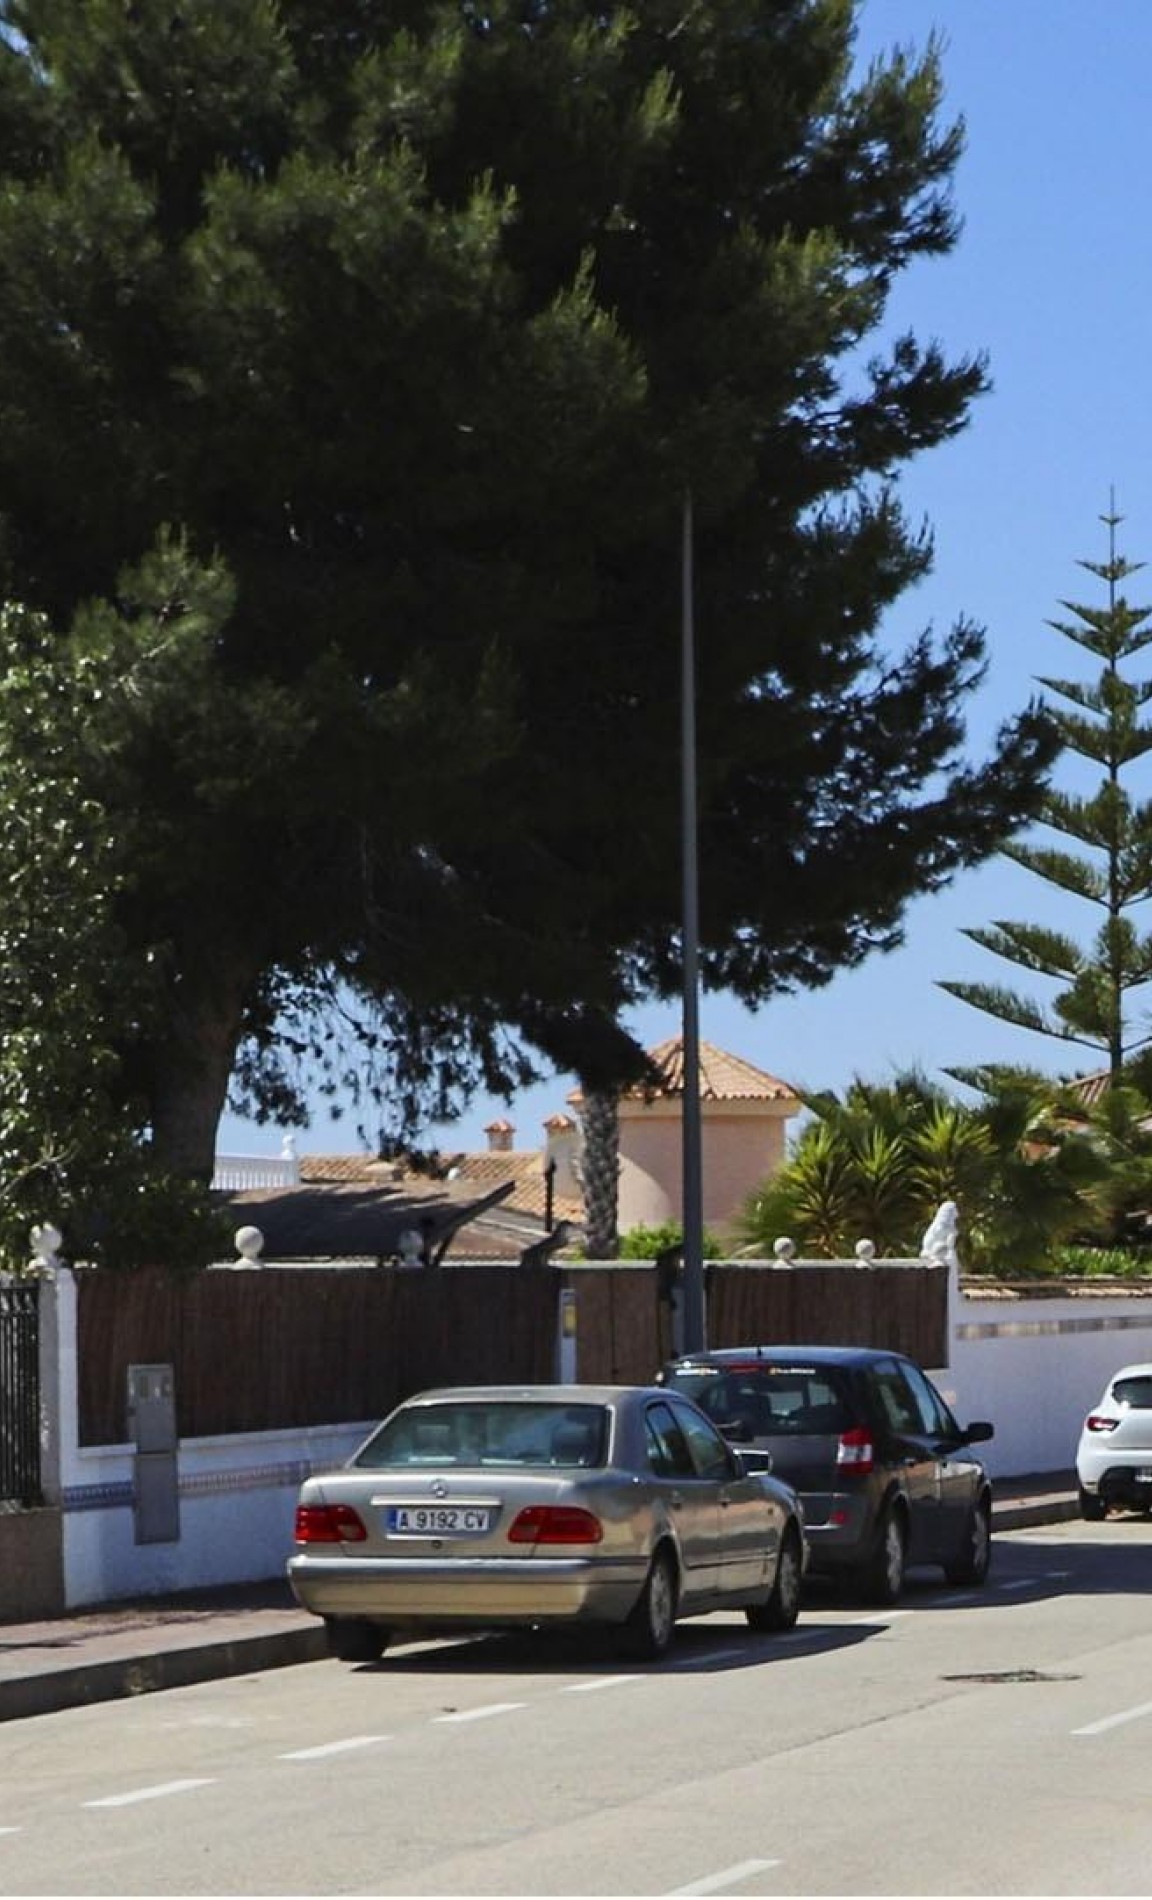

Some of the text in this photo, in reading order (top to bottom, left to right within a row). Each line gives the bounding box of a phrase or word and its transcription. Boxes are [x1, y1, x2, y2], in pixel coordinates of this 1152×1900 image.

[400, 1511, 486, 1528] A 9192 CV
